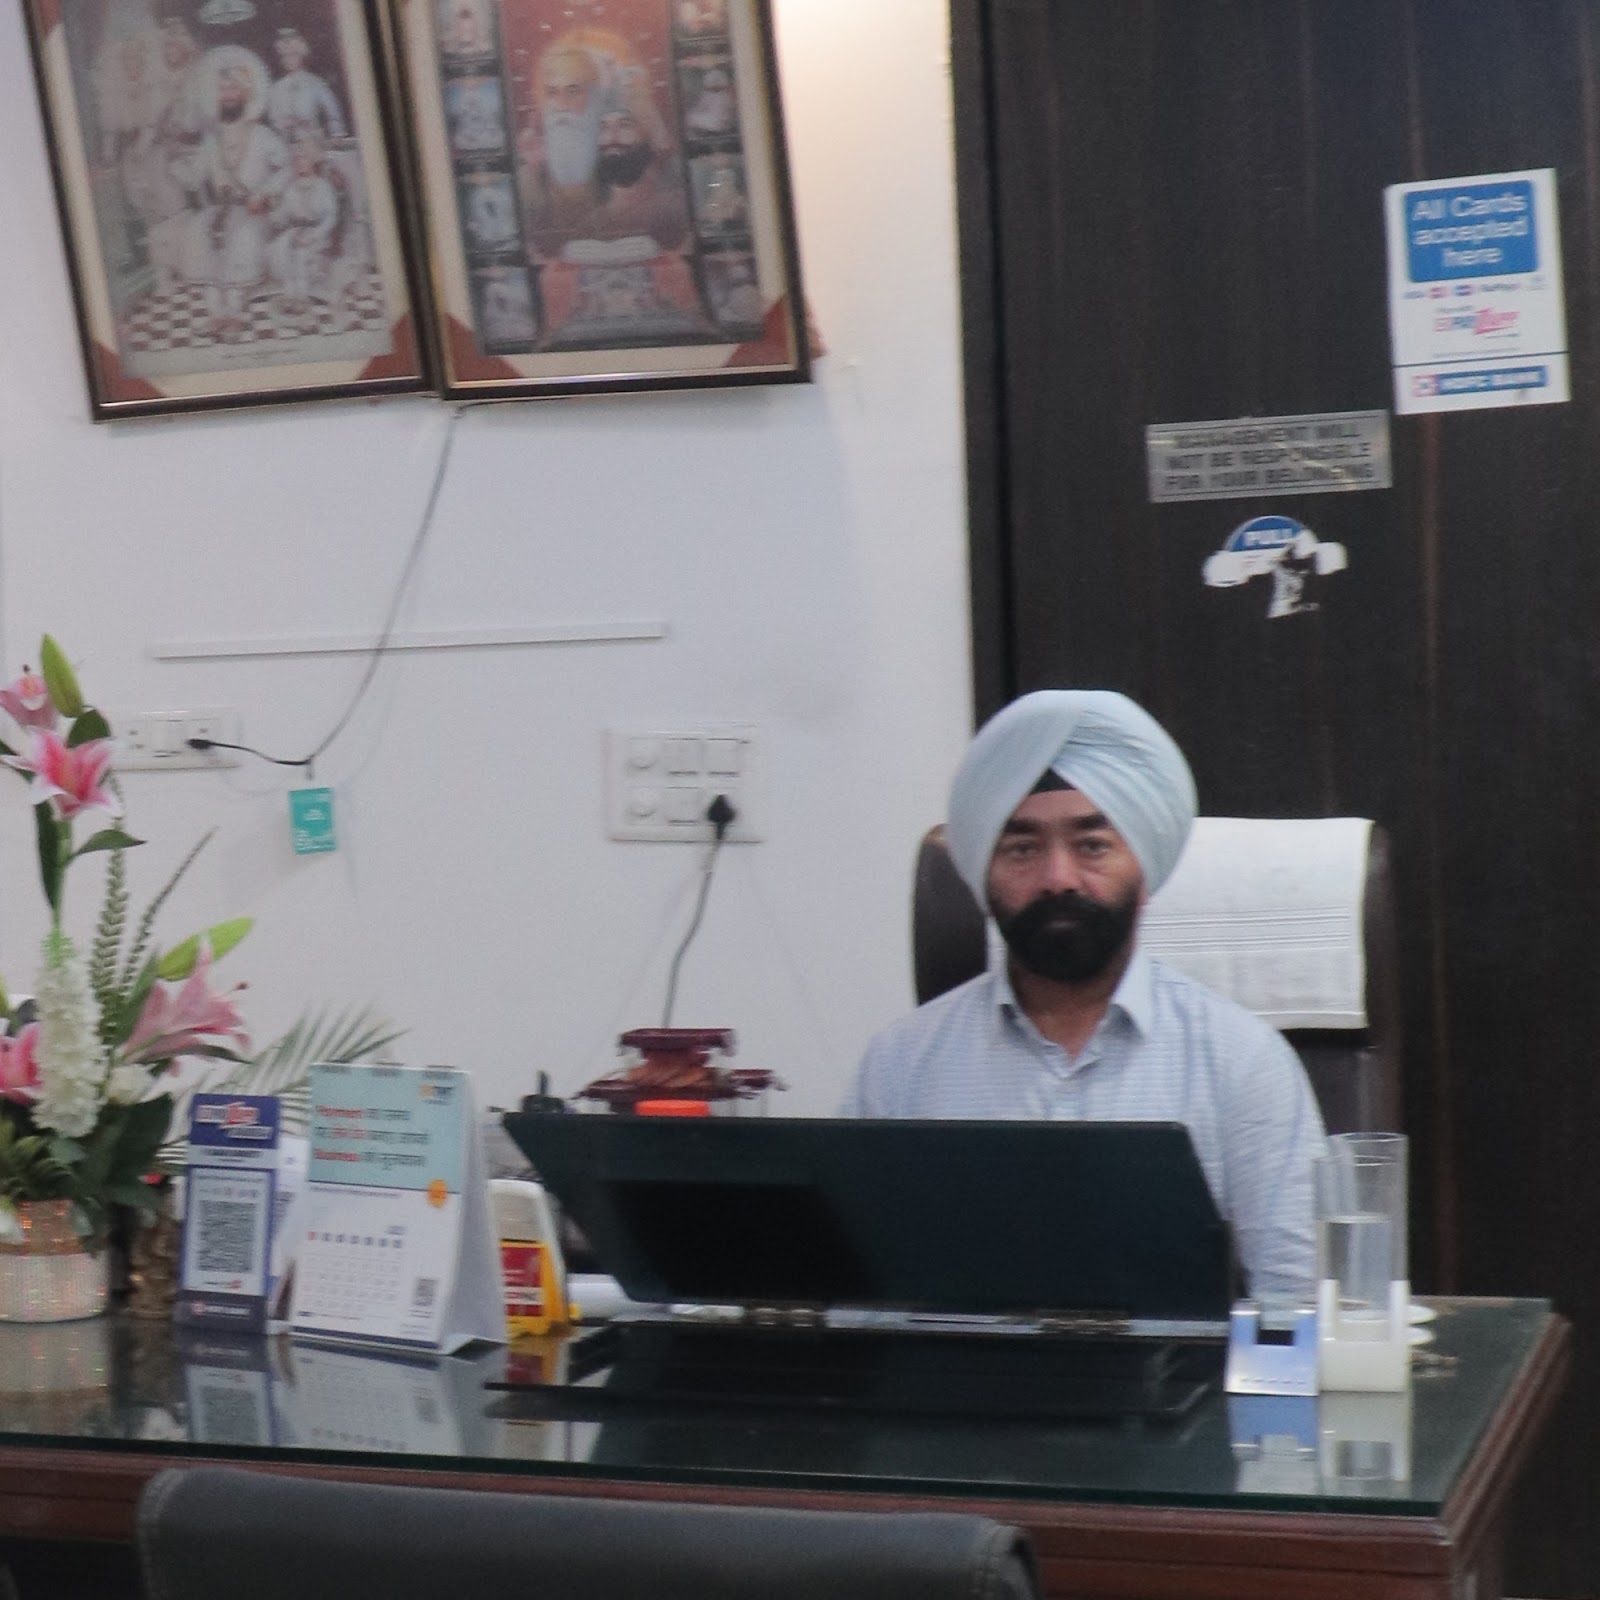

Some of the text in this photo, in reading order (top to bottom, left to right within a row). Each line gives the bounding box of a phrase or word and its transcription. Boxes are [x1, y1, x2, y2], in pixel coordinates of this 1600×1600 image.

[1412, 192, 1528, 221] All Cards
[1413, 215, 1529, 246] accepted
[1442, 247, 1503, 268] here
[1173, 423, 1362, 449] MANAGEMENT WILL
[1167, 442, 1371, 469] NOT BE RESPONSIBLE
[1165, 474, 1200, 490] FOR
[1209, 470, 1258, 487] YOUR
